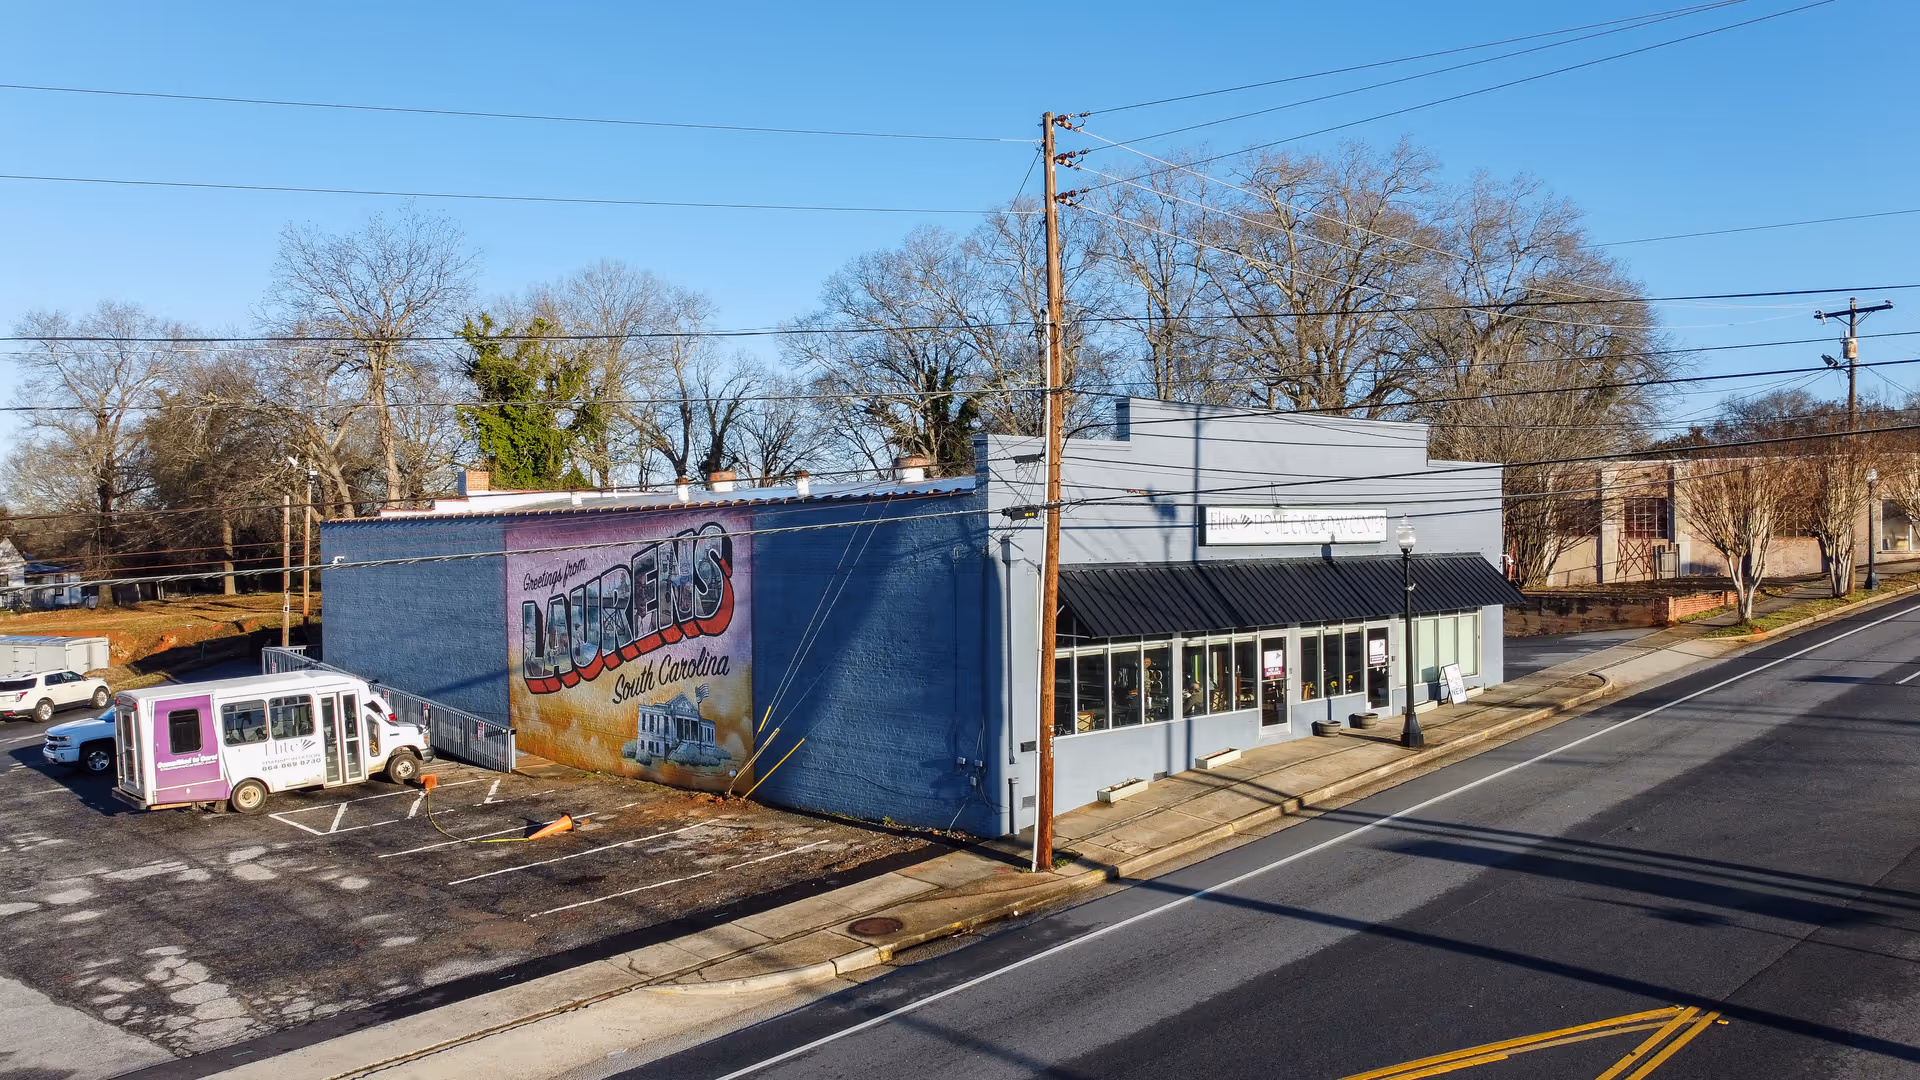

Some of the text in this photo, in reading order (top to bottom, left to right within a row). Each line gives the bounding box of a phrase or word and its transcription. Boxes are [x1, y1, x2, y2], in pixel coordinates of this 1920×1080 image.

[1210, 511, 1238, 530] Elite
[1254, 514, 1289, 535] HOME
[1291, 514, 1319, 534] CARE
[1349, 514, 1385, 534] CENTER
[523, 556, 588, 593] Greetings from
[522, 522, 734, 694] LAURENS
[612, 647, 730, 704] South Carolina
[1451, 687, 1464, 696] NEW
